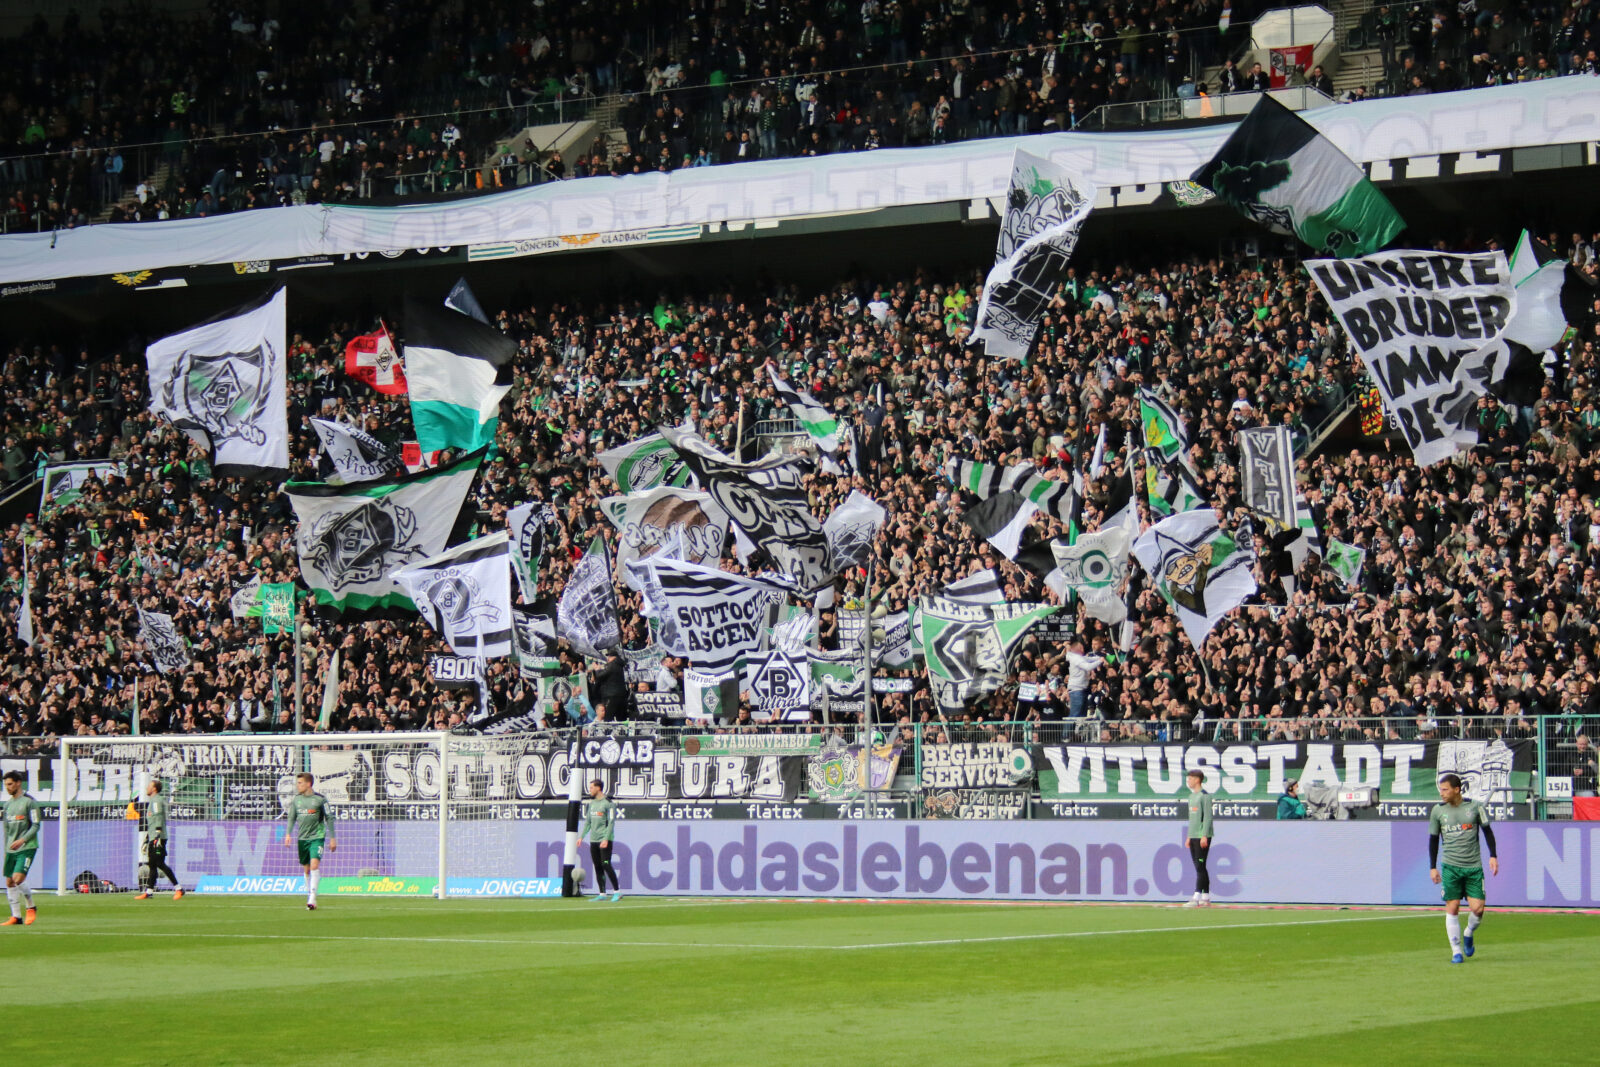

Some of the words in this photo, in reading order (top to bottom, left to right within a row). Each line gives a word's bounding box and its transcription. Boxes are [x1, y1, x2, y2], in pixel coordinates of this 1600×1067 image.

[601, 231, 648, 244] GLADBACH
[1313, 254, 1500, 301] UNSERE
[1342, 287, 1511, 352] BRÜDER
[677, 600, 761, 630] SOTTOC
[687, 621, 761, 652] ASCEN
[435, 657, 477, 679] 1900
[635, 693, 680, 704] SOTTO
[758, 694, 802, 711] Ultras
[714, 734, 812, 749] STADIONVERBOT
[921, 742, 1012, 767] BEGLEIT
[922, 763, 1009, 788] SERVICE
[1043, 743, 1425, 796] VITUSSTADT
[1548, 782, 1569, 792] 15/1
[43, 807, 80, 818] flaex
[407, 804, 457, 820] flatx
[489, 804, 541, 820] flatex
[658, 804, 713, 820] flatex
[747, 804, 802, 820] flatex
[1051, 802, 1098, 818] flatex
[1129, 802, 1177, 818] flatex
[1211, 802, 1260, 818] flatex
[1376, 803, 1427, 817] flatex
[535, 824, 1243, 898] machdaslebenan.de
